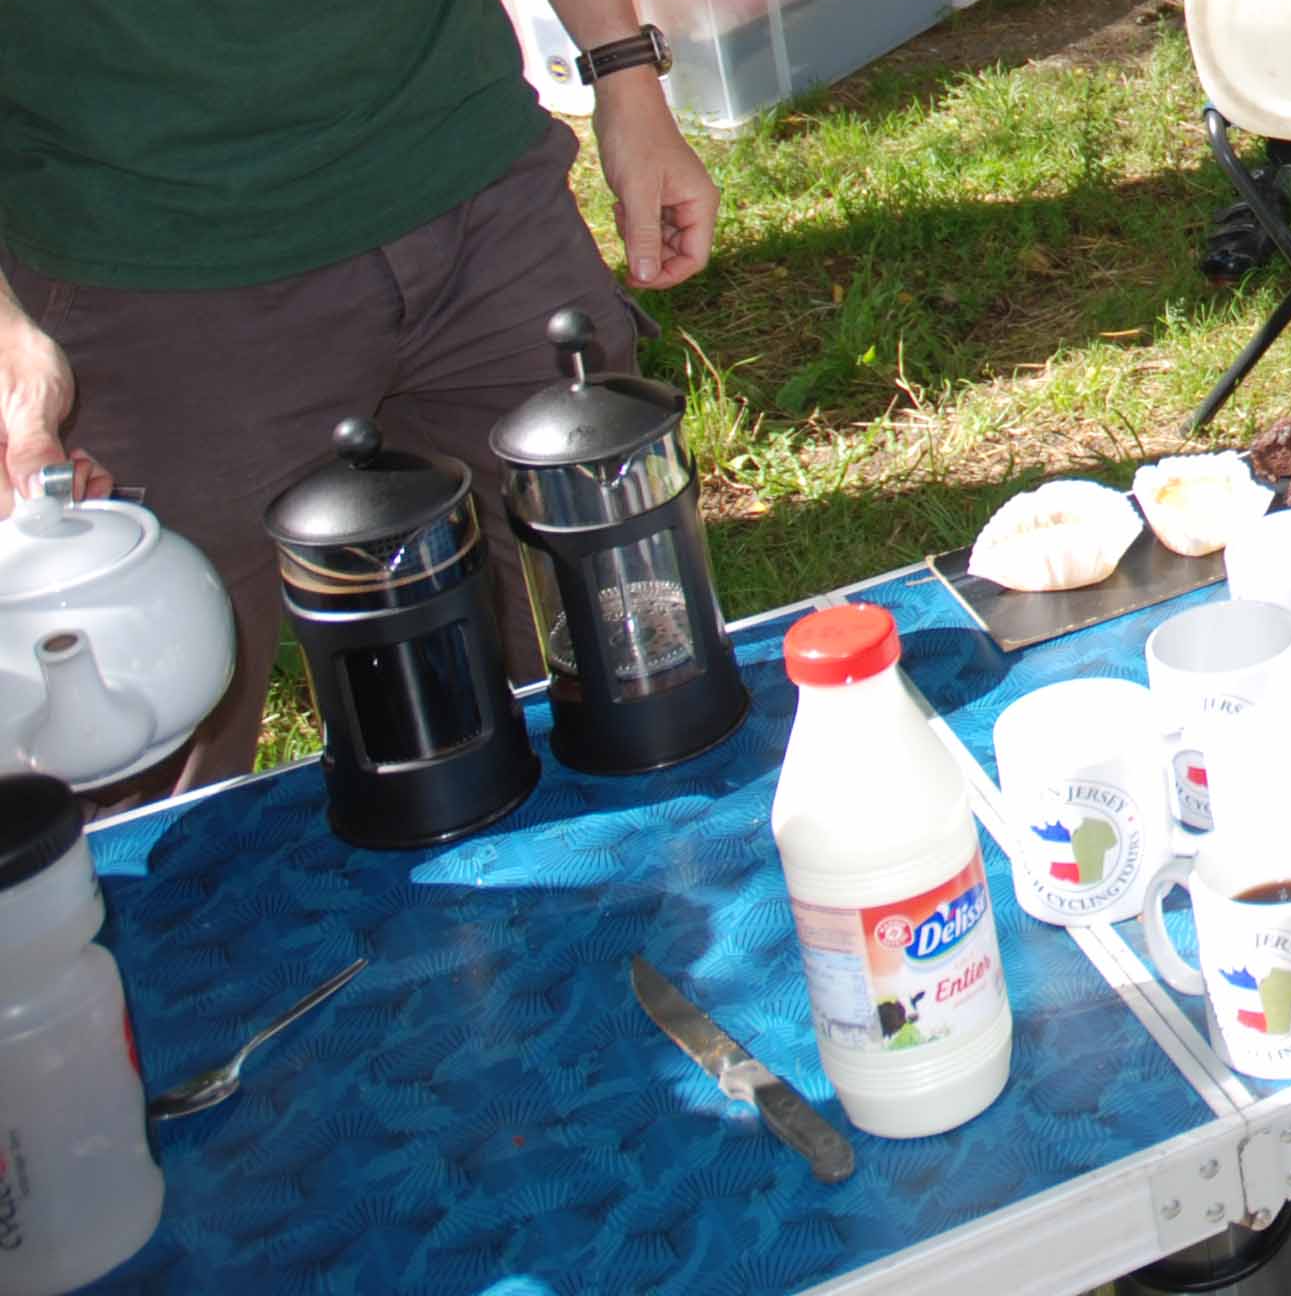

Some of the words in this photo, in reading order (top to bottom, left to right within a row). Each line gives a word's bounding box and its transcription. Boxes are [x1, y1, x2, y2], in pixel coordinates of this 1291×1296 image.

[1066, 784, 1128, 813] JERSEY
[1047, 883, 1121, 910] CYCLING
[1117, 830, 1139, 884] TOURS
